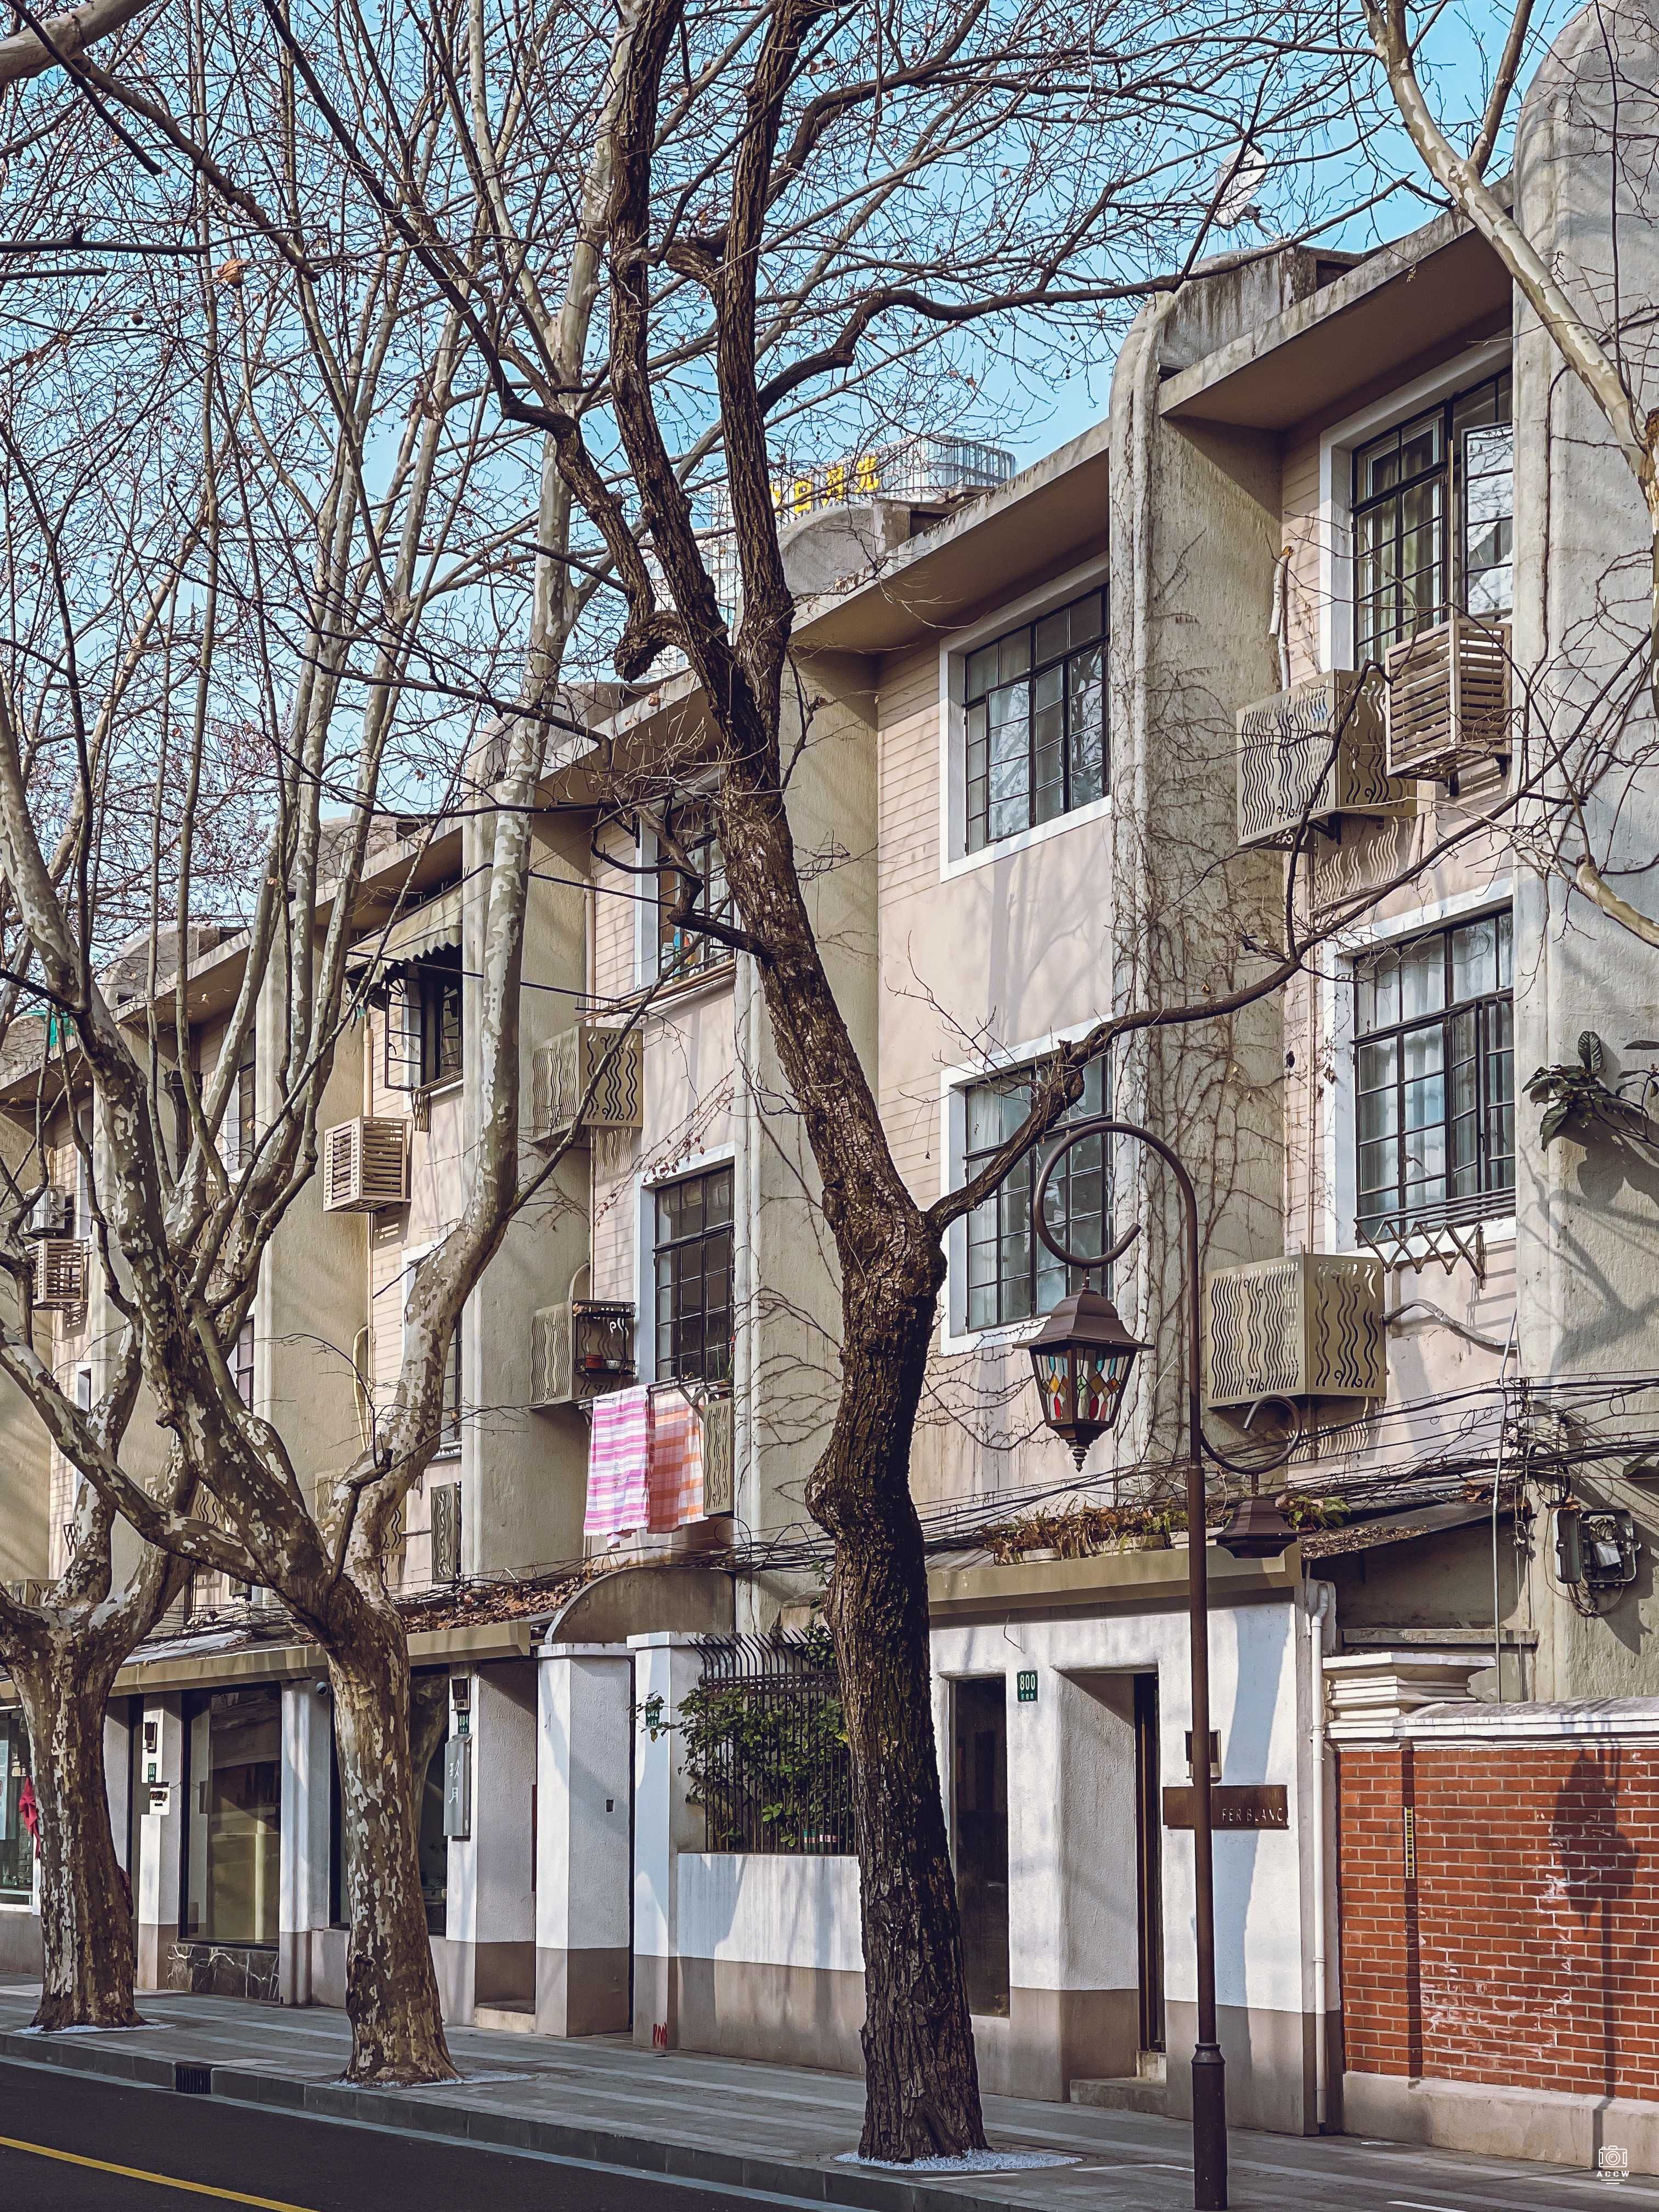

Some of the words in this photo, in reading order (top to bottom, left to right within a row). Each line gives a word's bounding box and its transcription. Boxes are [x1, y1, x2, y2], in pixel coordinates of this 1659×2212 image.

[1020, 1674, 1035, 1690] 800
[459, 1715, 469, 1726] 804
[448, 1759, 460, 1804] 玖月
[1222, 1808, 1242, 1822] FER
[1246, 1808, 1283, 1822] BLANC
